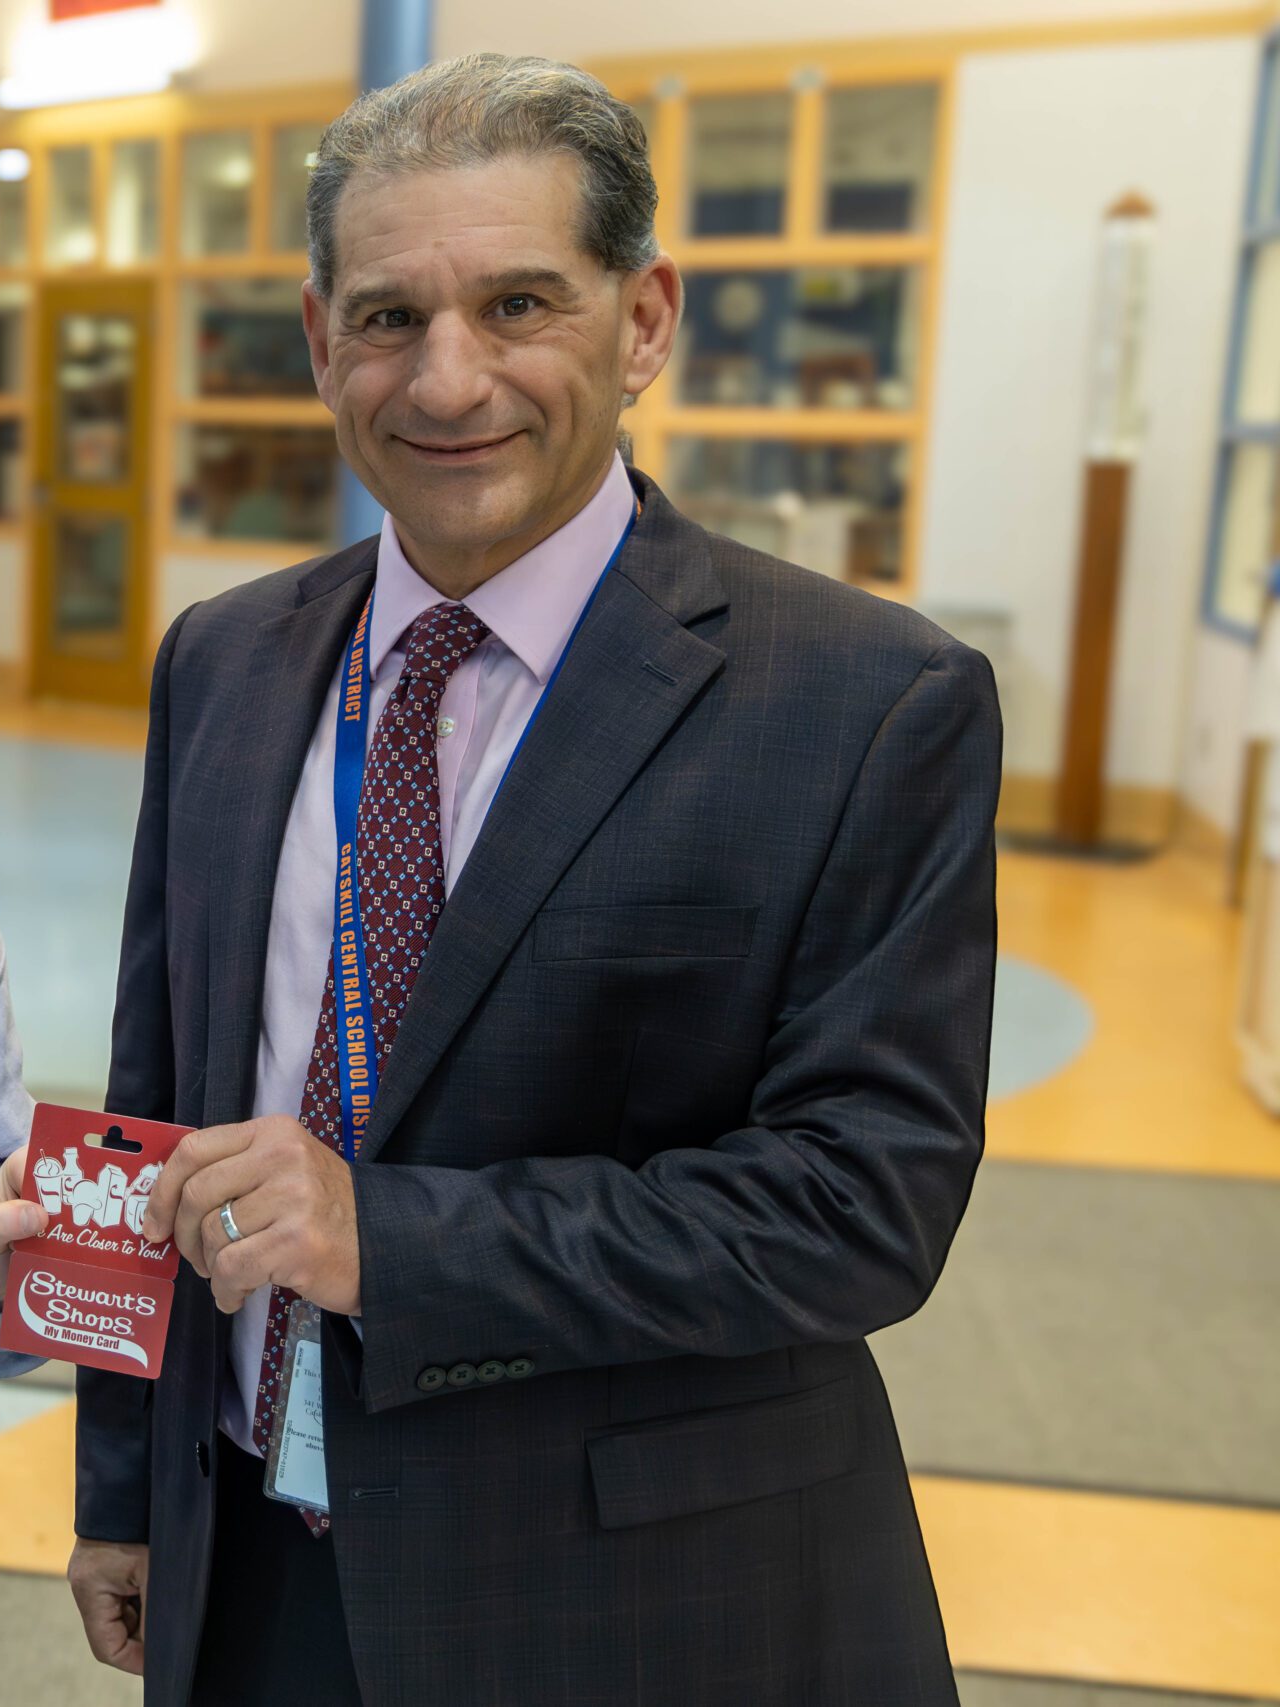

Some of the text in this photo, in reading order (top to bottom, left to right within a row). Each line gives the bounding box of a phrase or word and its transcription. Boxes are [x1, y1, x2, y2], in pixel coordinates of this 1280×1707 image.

[345, 647, 364, 722] DISTRICT
[339, 843, 353, 926] CATSKILL
[340, 930, 361, 1012] CENTRAL
[345, 1015, 368, 1089] SCHOOL
[47, 1223, 75, 1243] Are
[76, 1228, 120, 1252] Closer
[121, 1239, 136, 1255] to
[138, 1239, 171, 1260] You!
[29, 1271, 157, 1316] Stewart's
[45, 1299, 133, 1335] Shops
[44, 1325, 120, 1350] My Money Card
